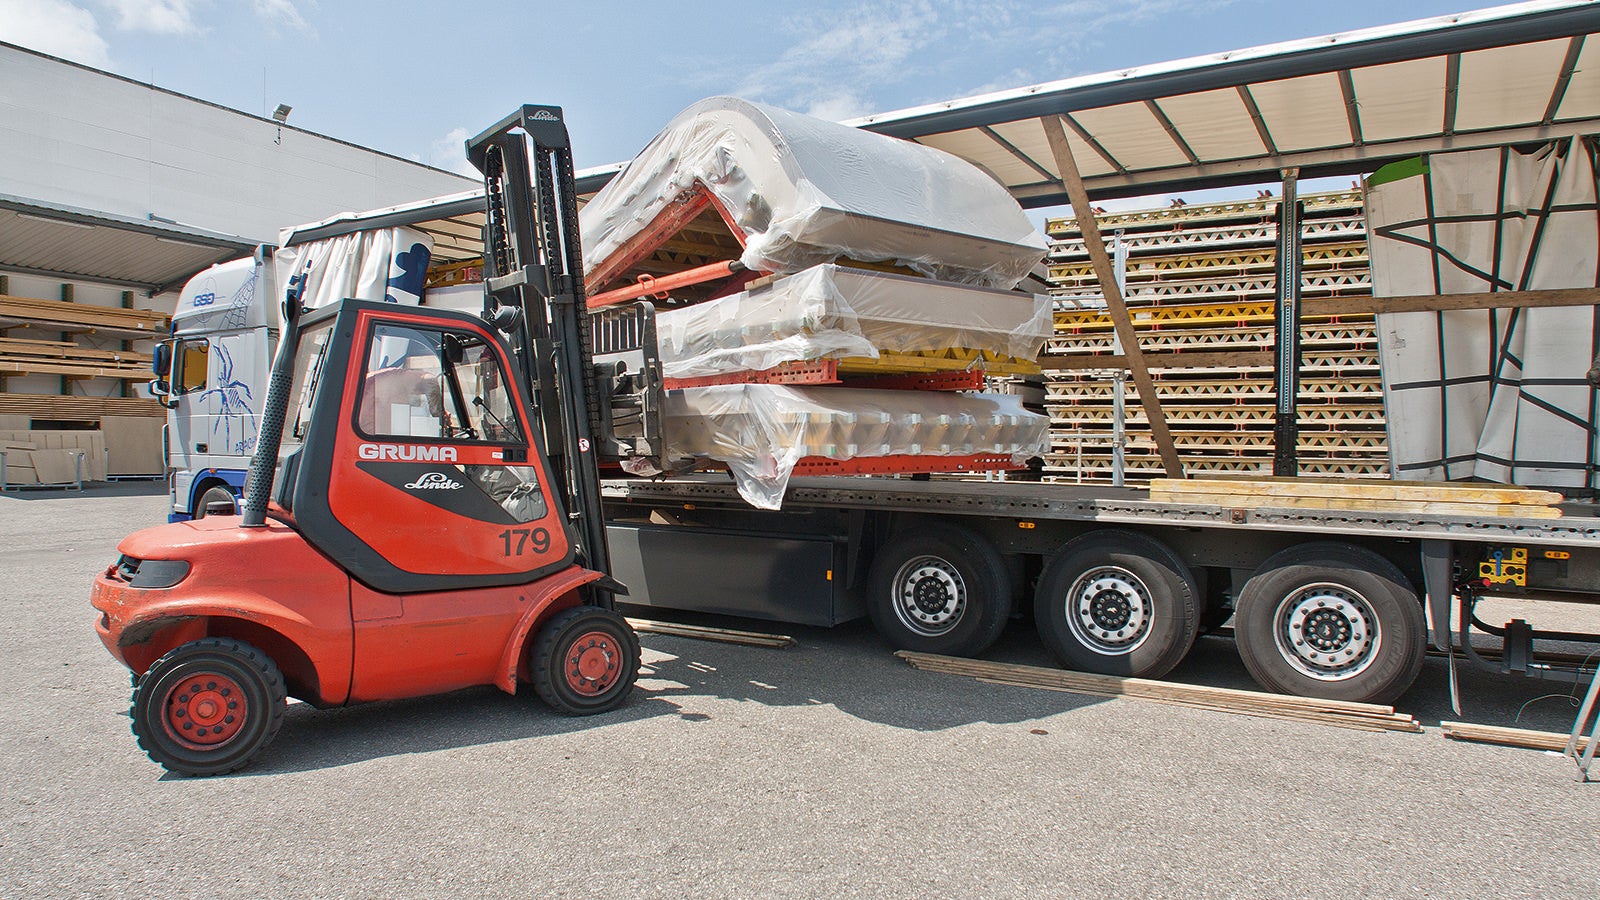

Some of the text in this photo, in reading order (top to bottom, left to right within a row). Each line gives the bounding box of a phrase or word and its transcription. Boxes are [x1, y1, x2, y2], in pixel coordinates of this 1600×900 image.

[528, 110, 560, 121] Linde
[358, 443, 458, 462] GRUMA
[404, 472, 464, 490] Linde
[498, 527, 551, 557] 179
